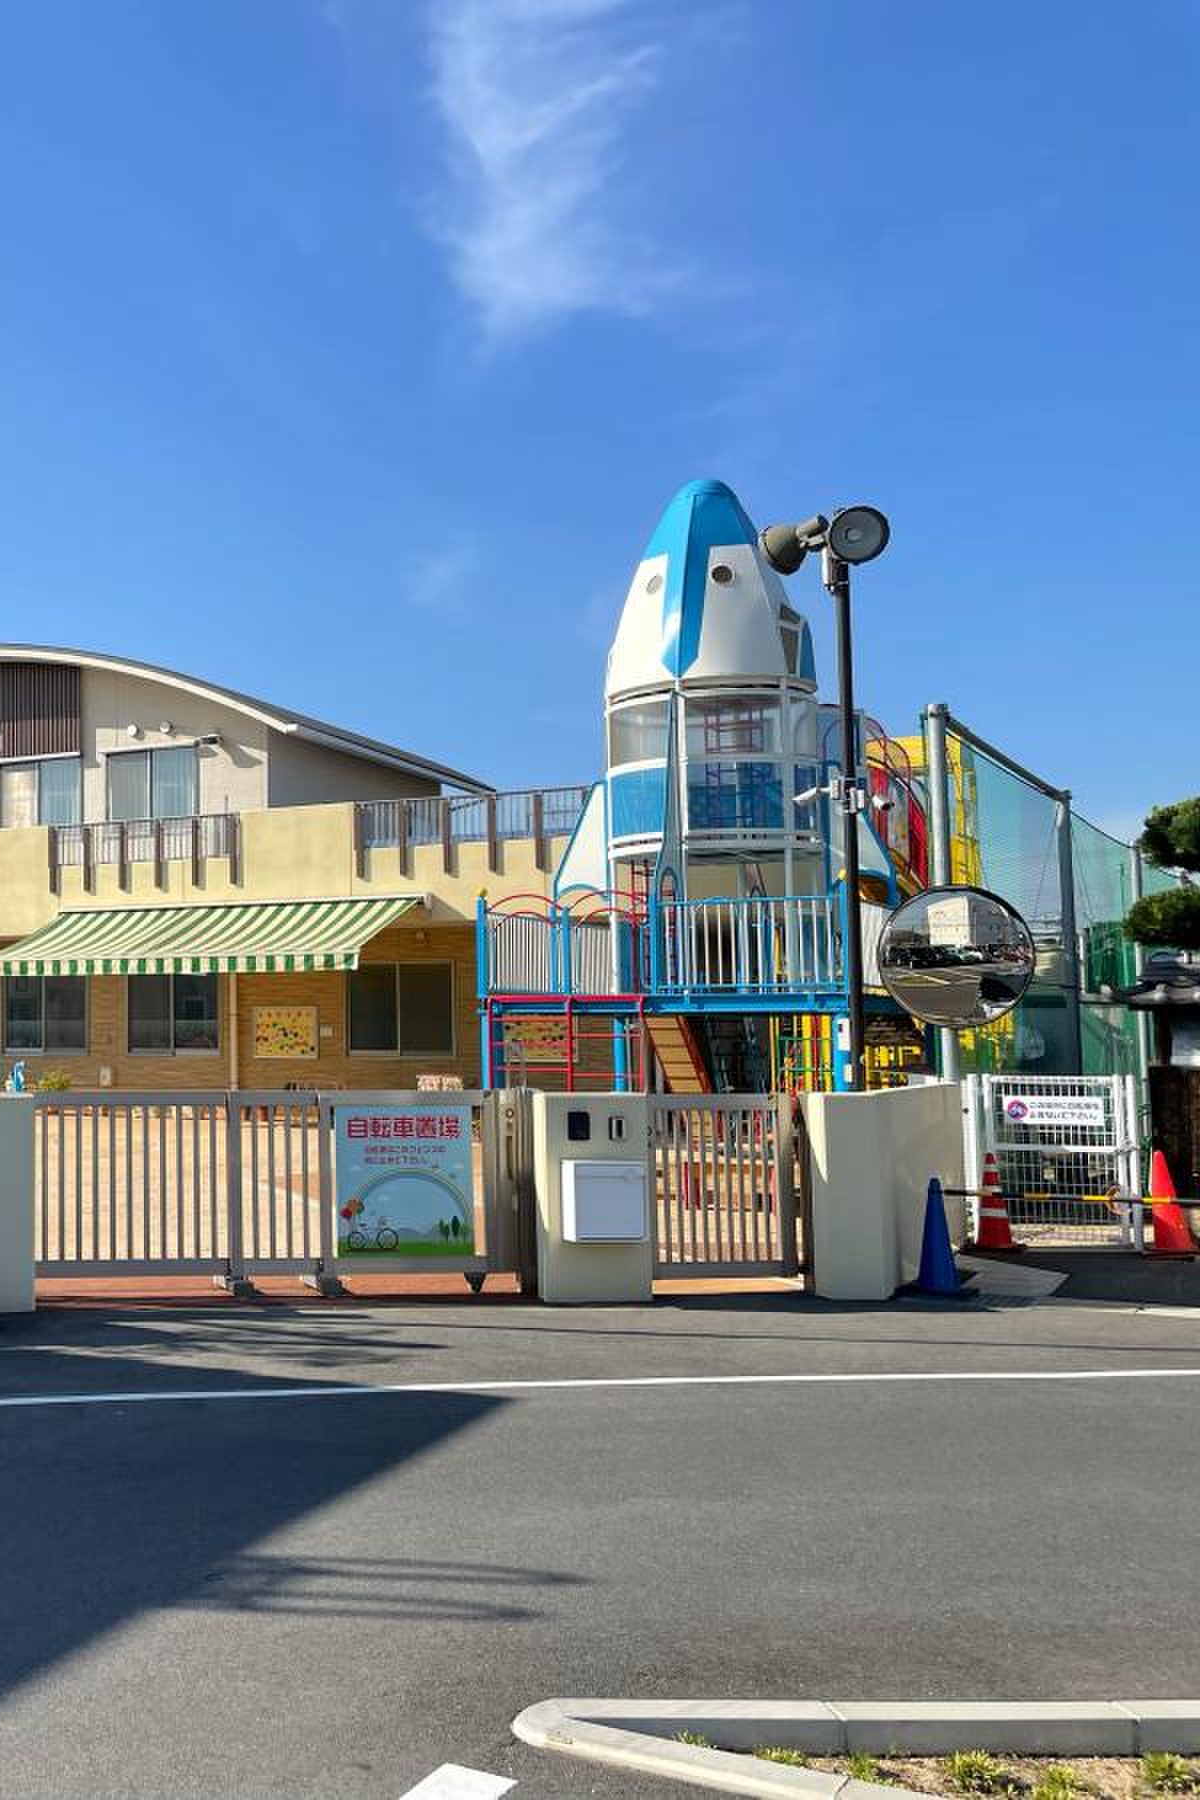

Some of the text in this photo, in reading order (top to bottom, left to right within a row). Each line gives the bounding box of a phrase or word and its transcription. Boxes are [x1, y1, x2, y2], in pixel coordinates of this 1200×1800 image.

[347, 1115, 460, 1138] 自転車置場
